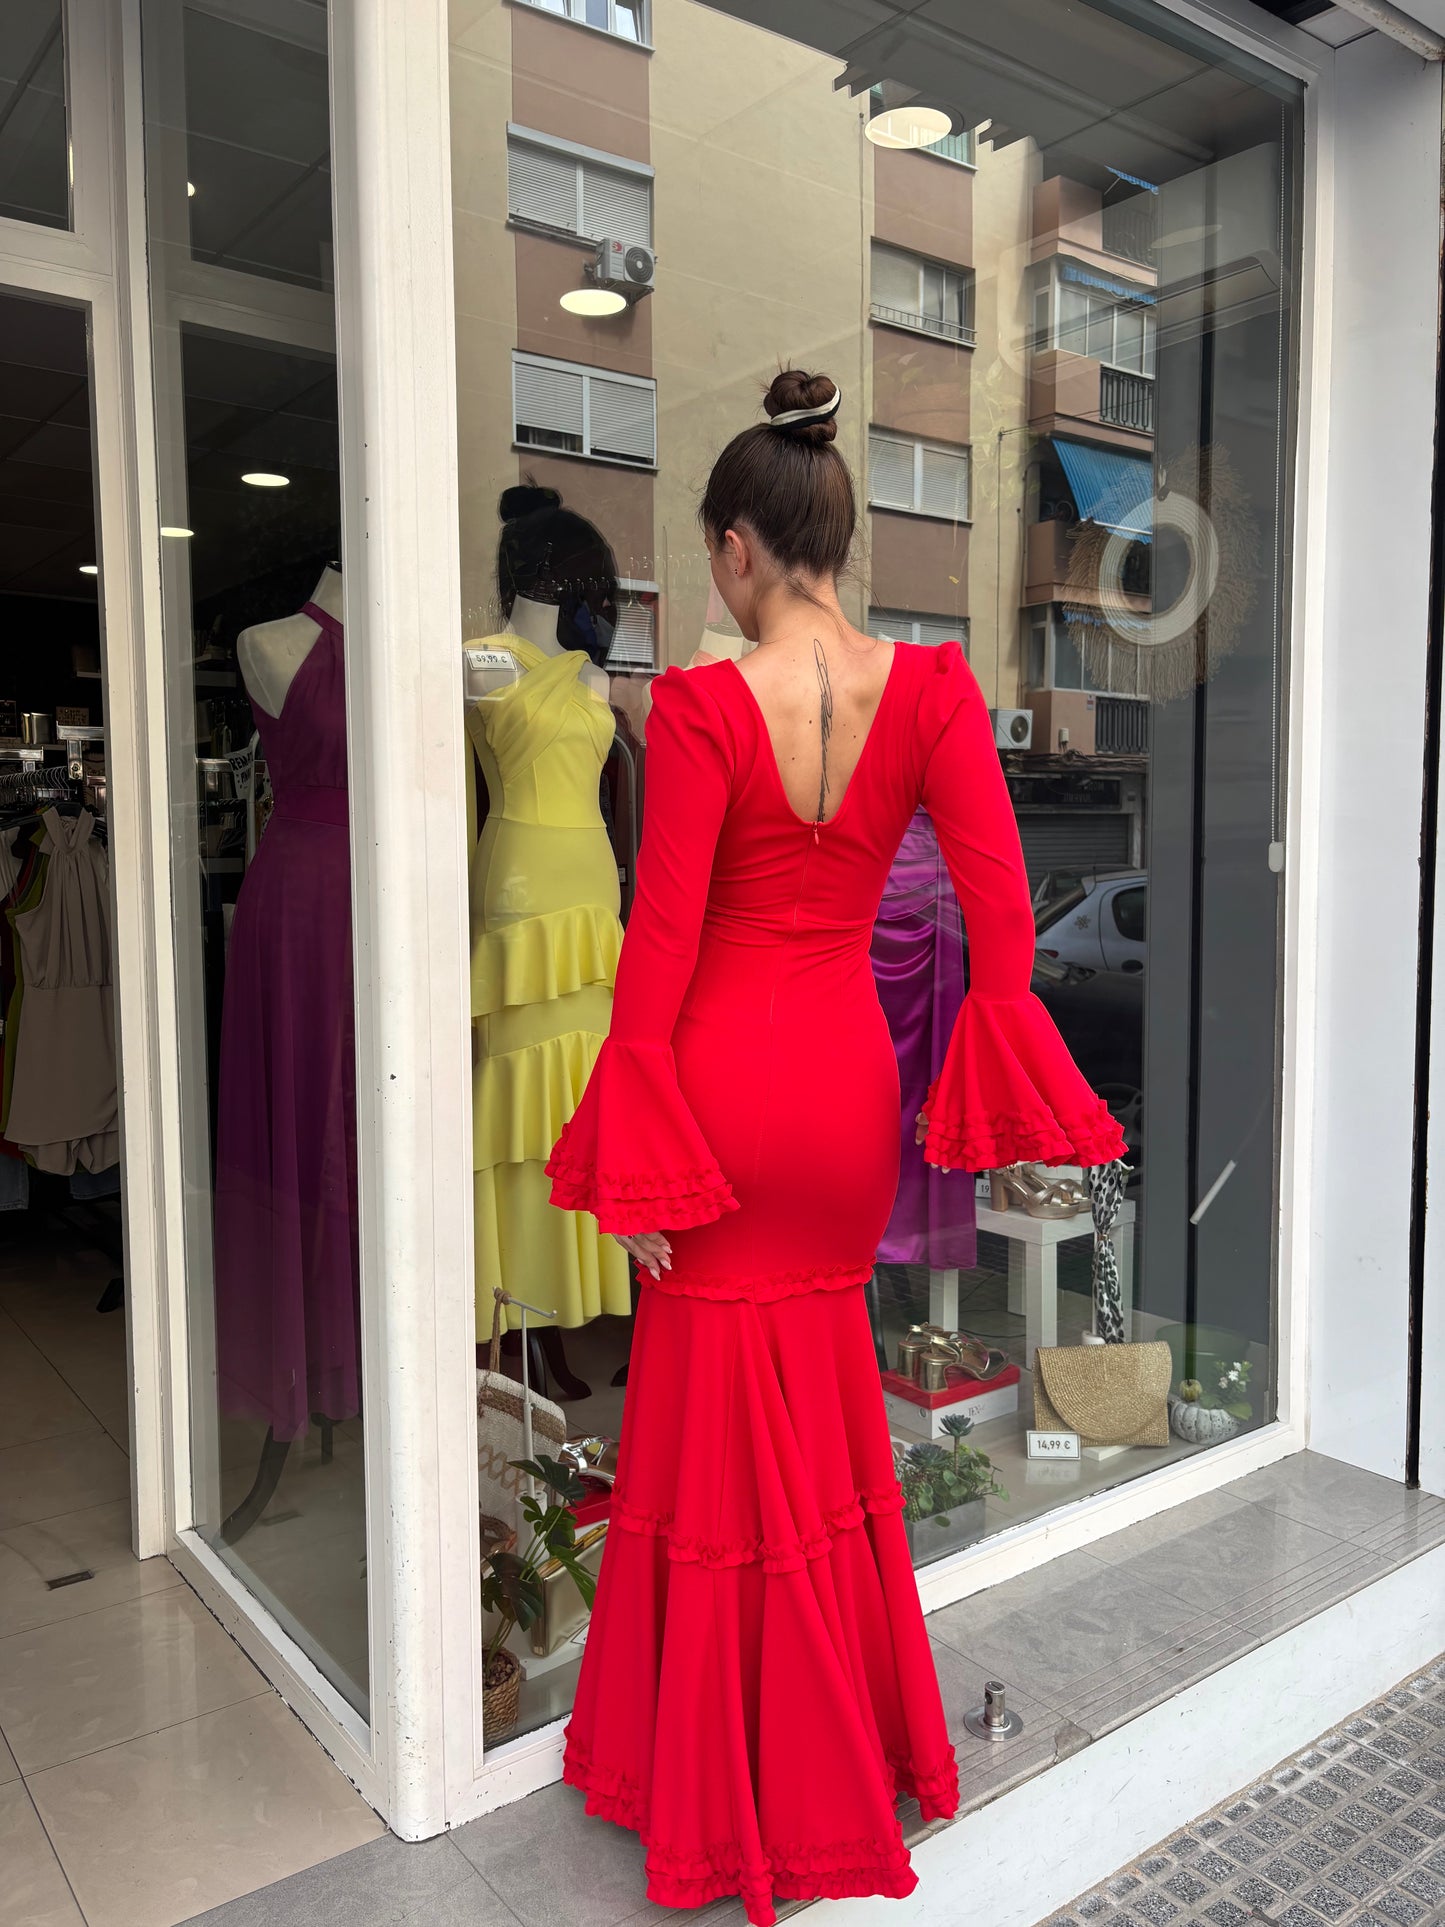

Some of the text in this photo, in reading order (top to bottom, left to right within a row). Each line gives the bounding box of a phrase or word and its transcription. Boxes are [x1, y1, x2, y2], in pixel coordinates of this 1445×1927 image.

[475, 654, 498, 664] 59,99
[1037, 1440, 1071, 1450] 14,99 €
